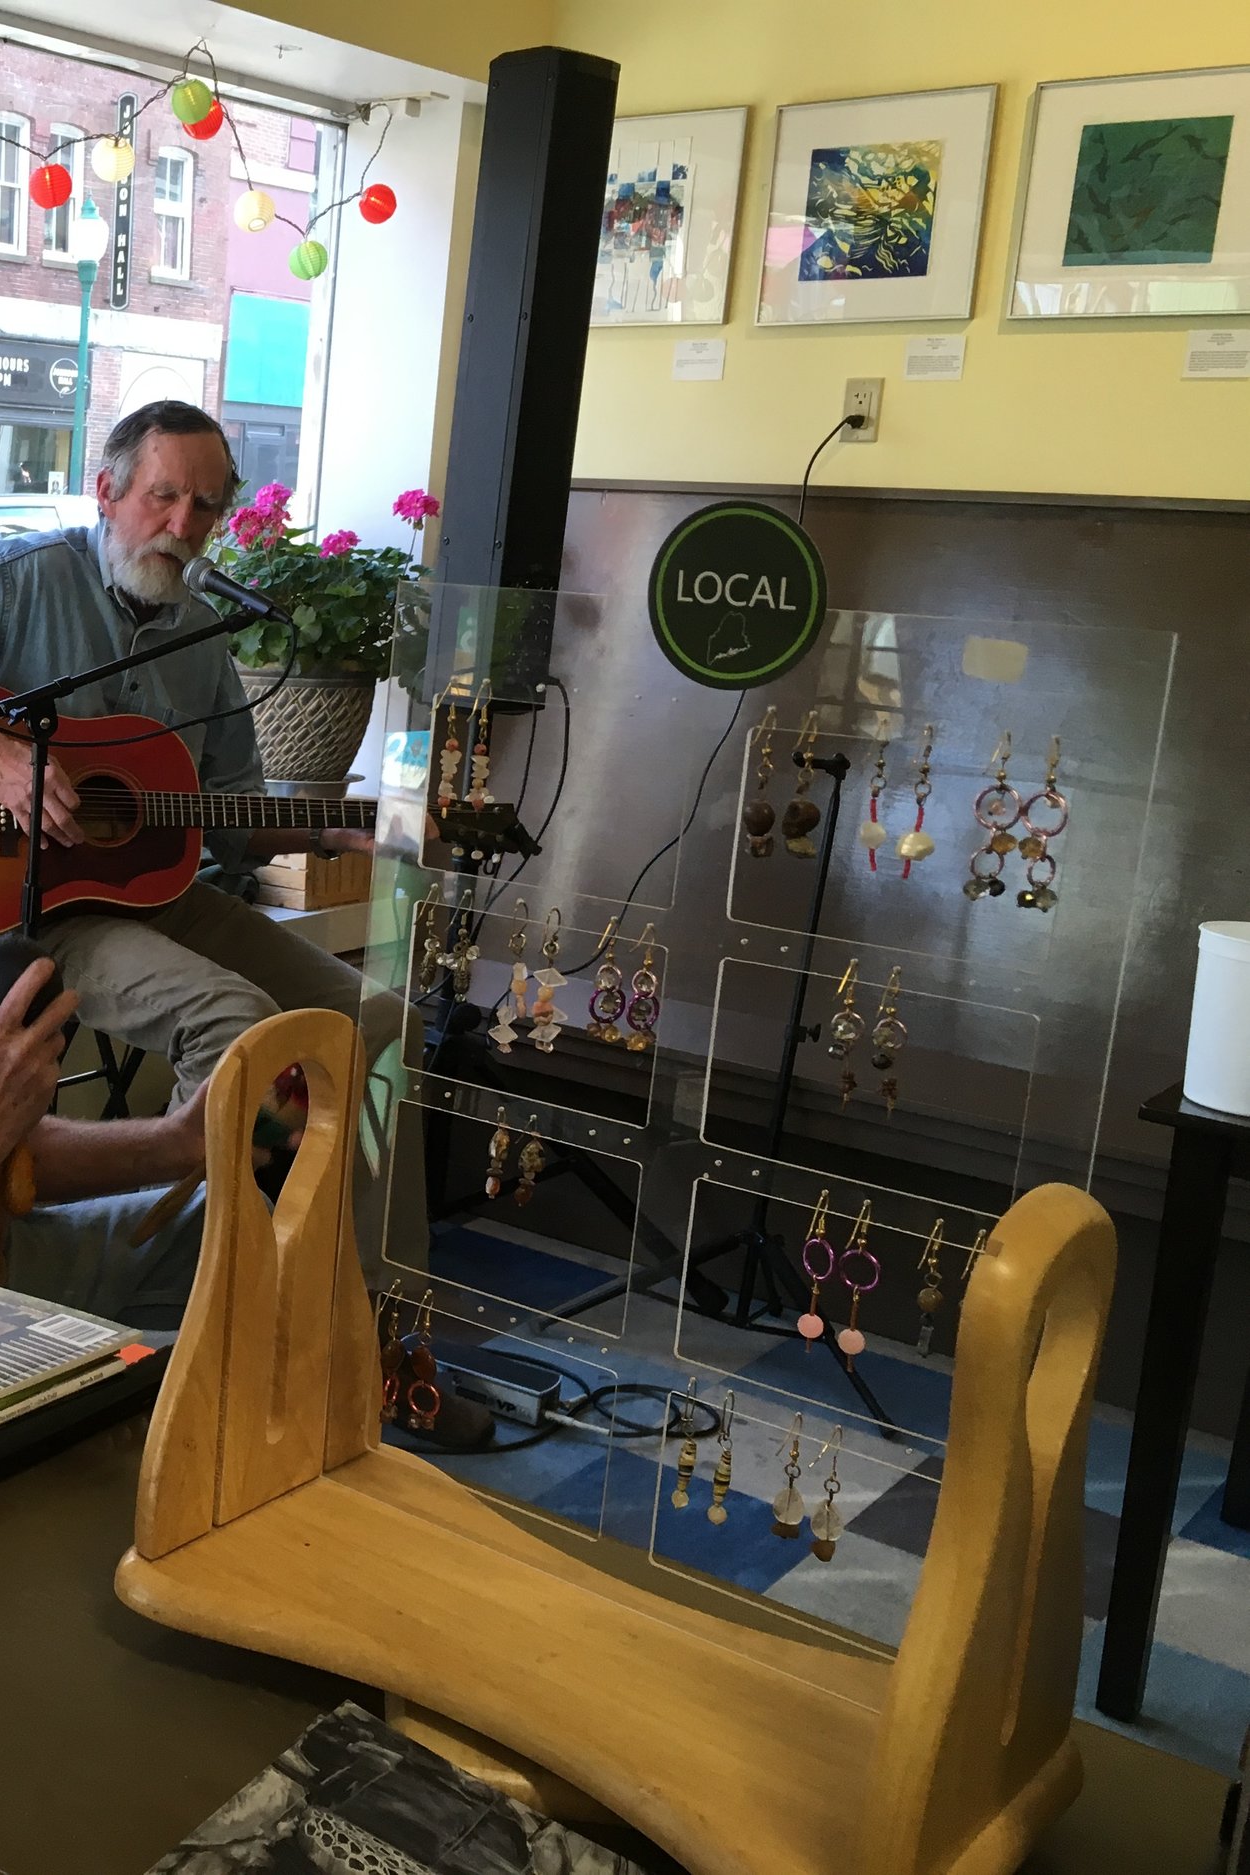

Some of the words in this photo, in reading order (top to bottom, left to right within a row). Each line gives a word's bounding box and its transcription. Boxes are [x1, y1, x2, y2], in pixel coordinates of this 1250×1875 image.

[119, 104, 131, 217] JOON
[116, 233, 126, 295] HALL
[676, 569, 797, 611] LOCAL
